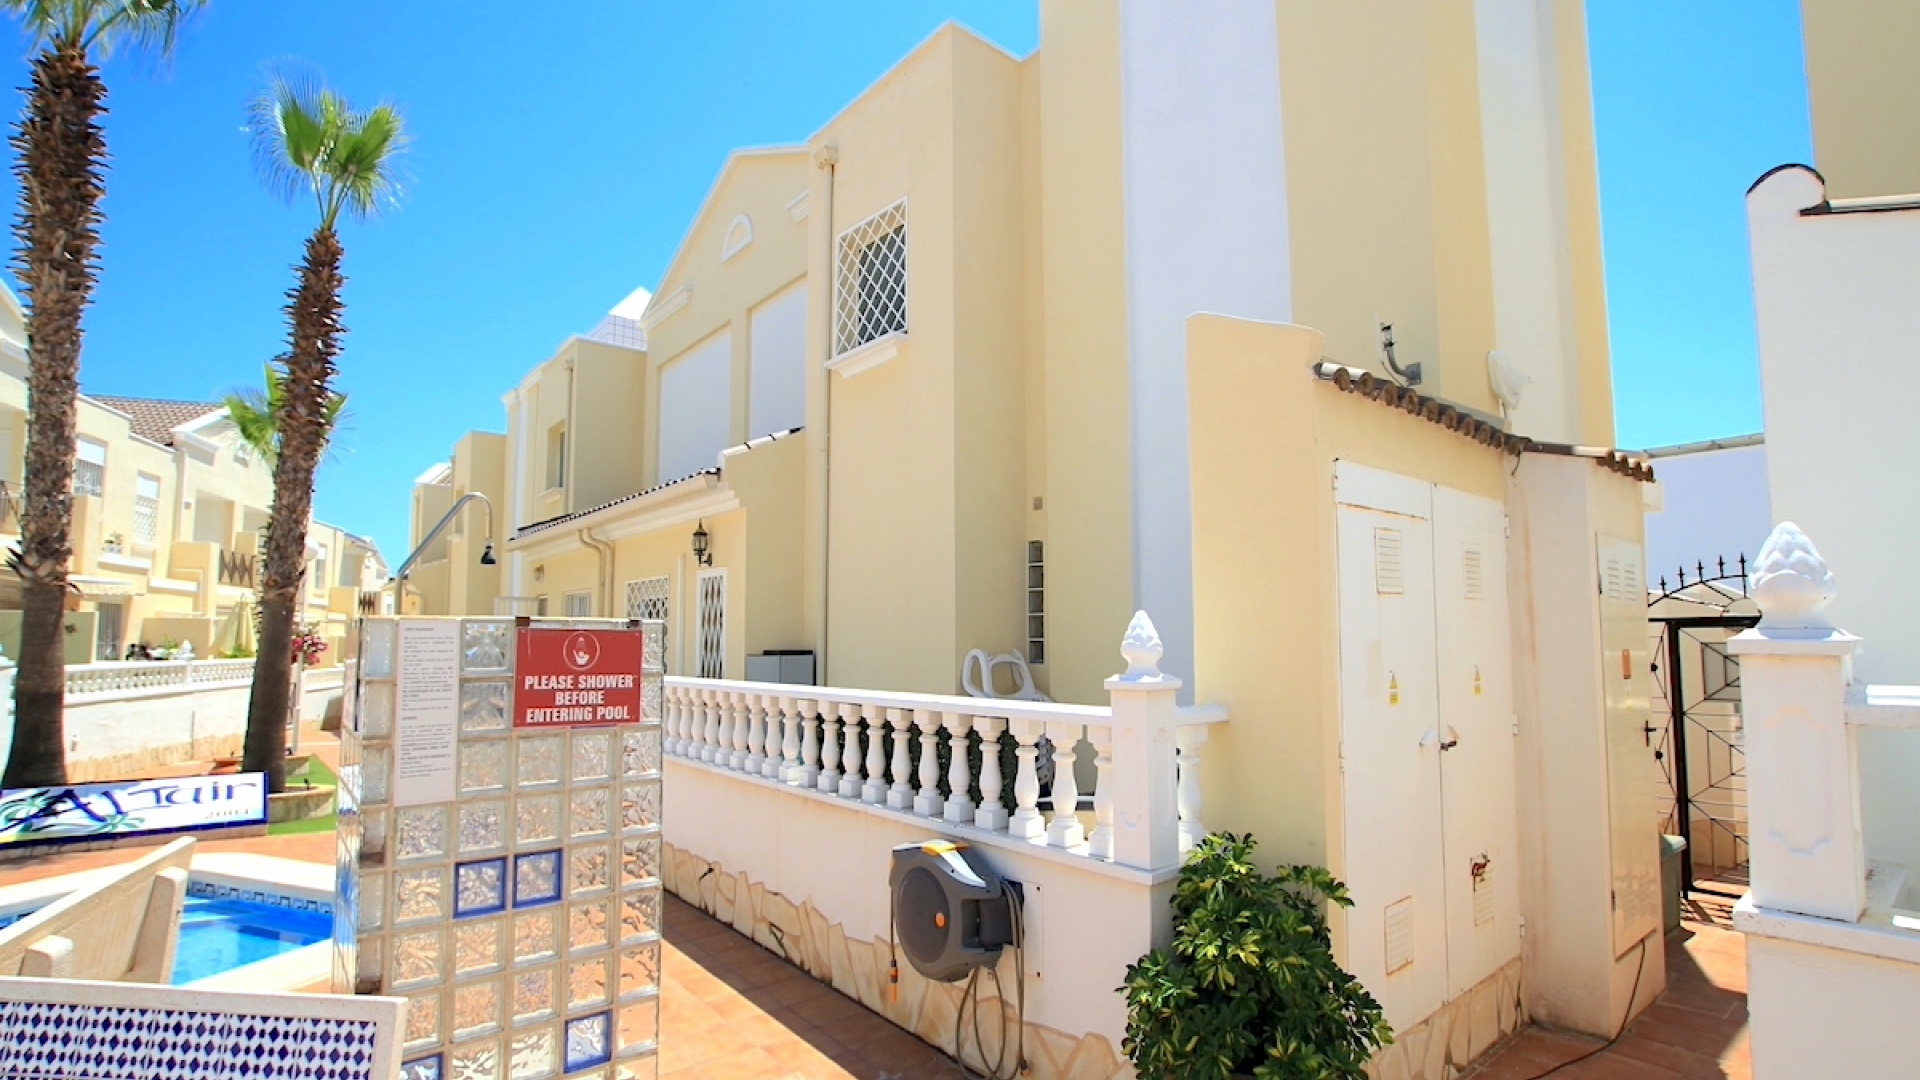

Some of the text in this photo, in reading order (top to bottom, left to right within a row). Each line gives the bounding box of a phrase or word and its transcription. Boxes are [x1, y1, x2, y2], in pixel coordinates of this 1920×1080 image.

[525, 674, 633, 690] PLEASE SHOWER
[555, 690, 605, 706] BEFORE
[526, 705, 630, 723] ENTERING POOL
